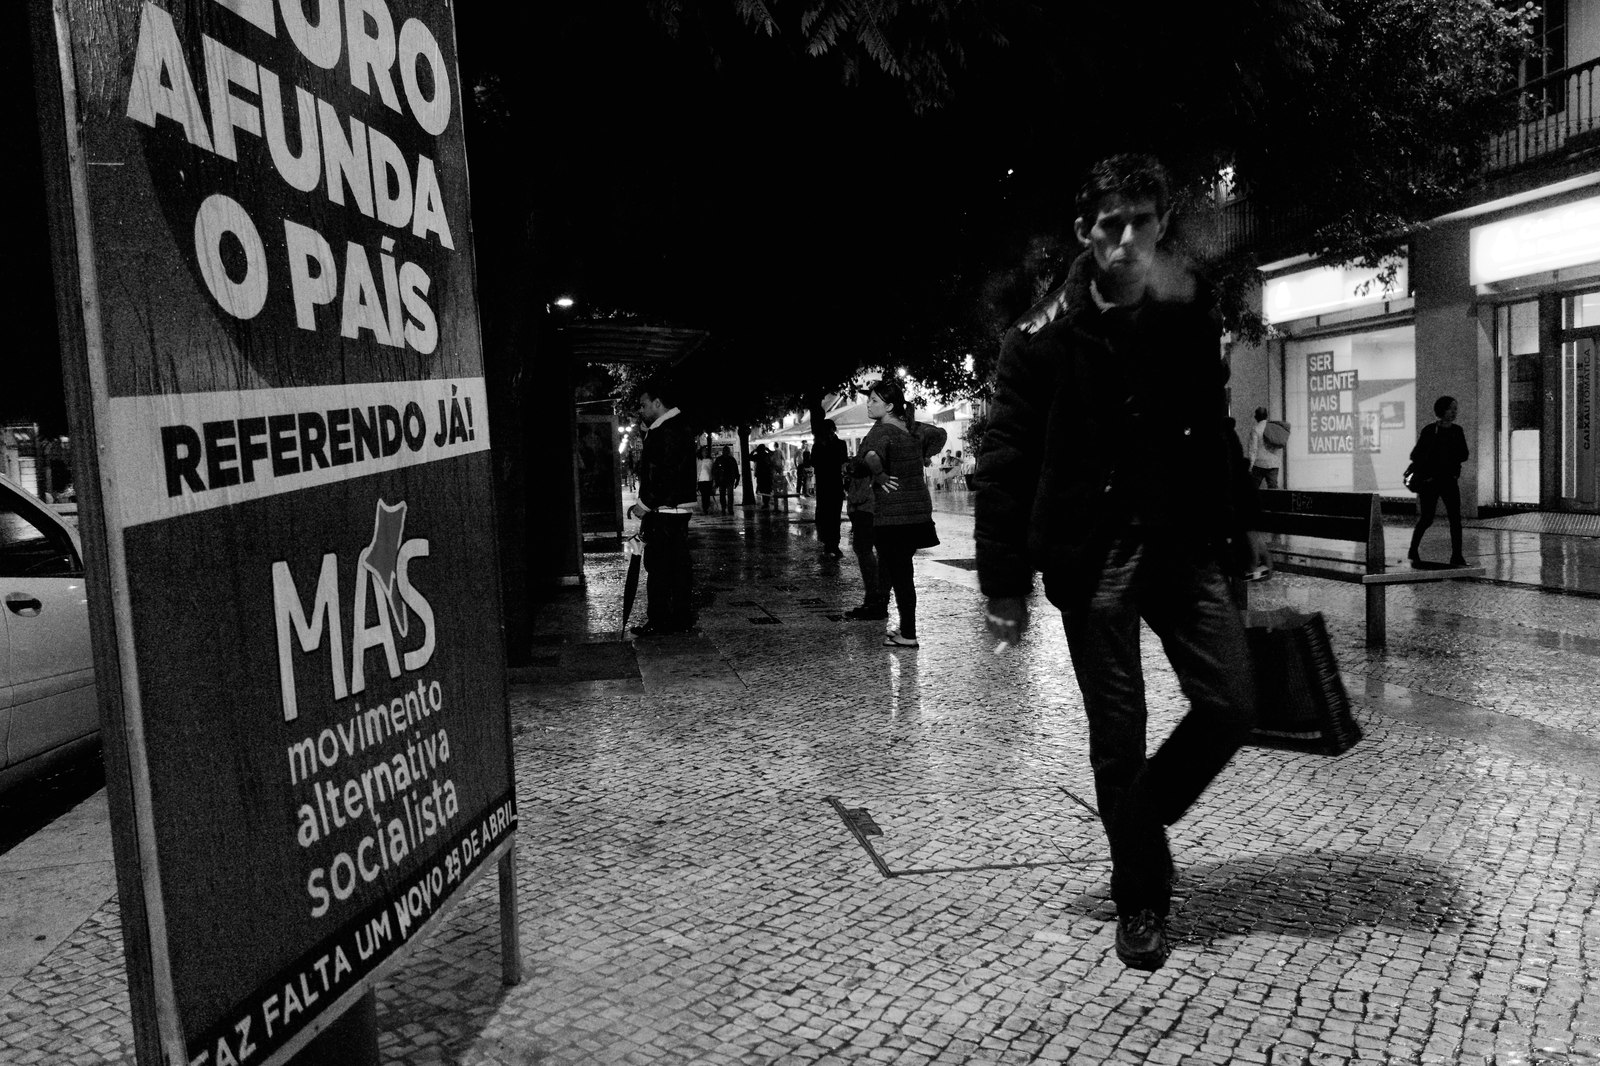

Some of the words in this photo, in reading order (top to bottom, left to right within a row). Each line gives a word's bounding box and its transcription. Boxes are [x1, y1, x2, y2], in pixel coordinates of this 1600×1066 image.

[127, 1, 455, 250] AFUNDA
[194, 193, 269, 320] O
[284, 219, 438, 354] PAÍS
[1309, 354, 1332, 372] SER
[1309, 372, 1355, 391] CLIENTE
[1310, 395, 1338, 412] MAIS
[160, 401, 427, 498] REFERENDO
[434, 384, 476, 448] JÁ!
[271, 538, 436, 721] MAS
[287, 679, 443, 786] movimento
[297, 728, 450, 848] alternativa
[307, 777, 459, 918] socialista
[262, 945, 352, 1038] FALTA
[354, 910, 393, 961] UM
[393, 866, 443, 940] NOVO
[445, 847, 462, 885] 25
[461, 828, 481, 866] DE
[482, 800, 518, 849] ABRIL
